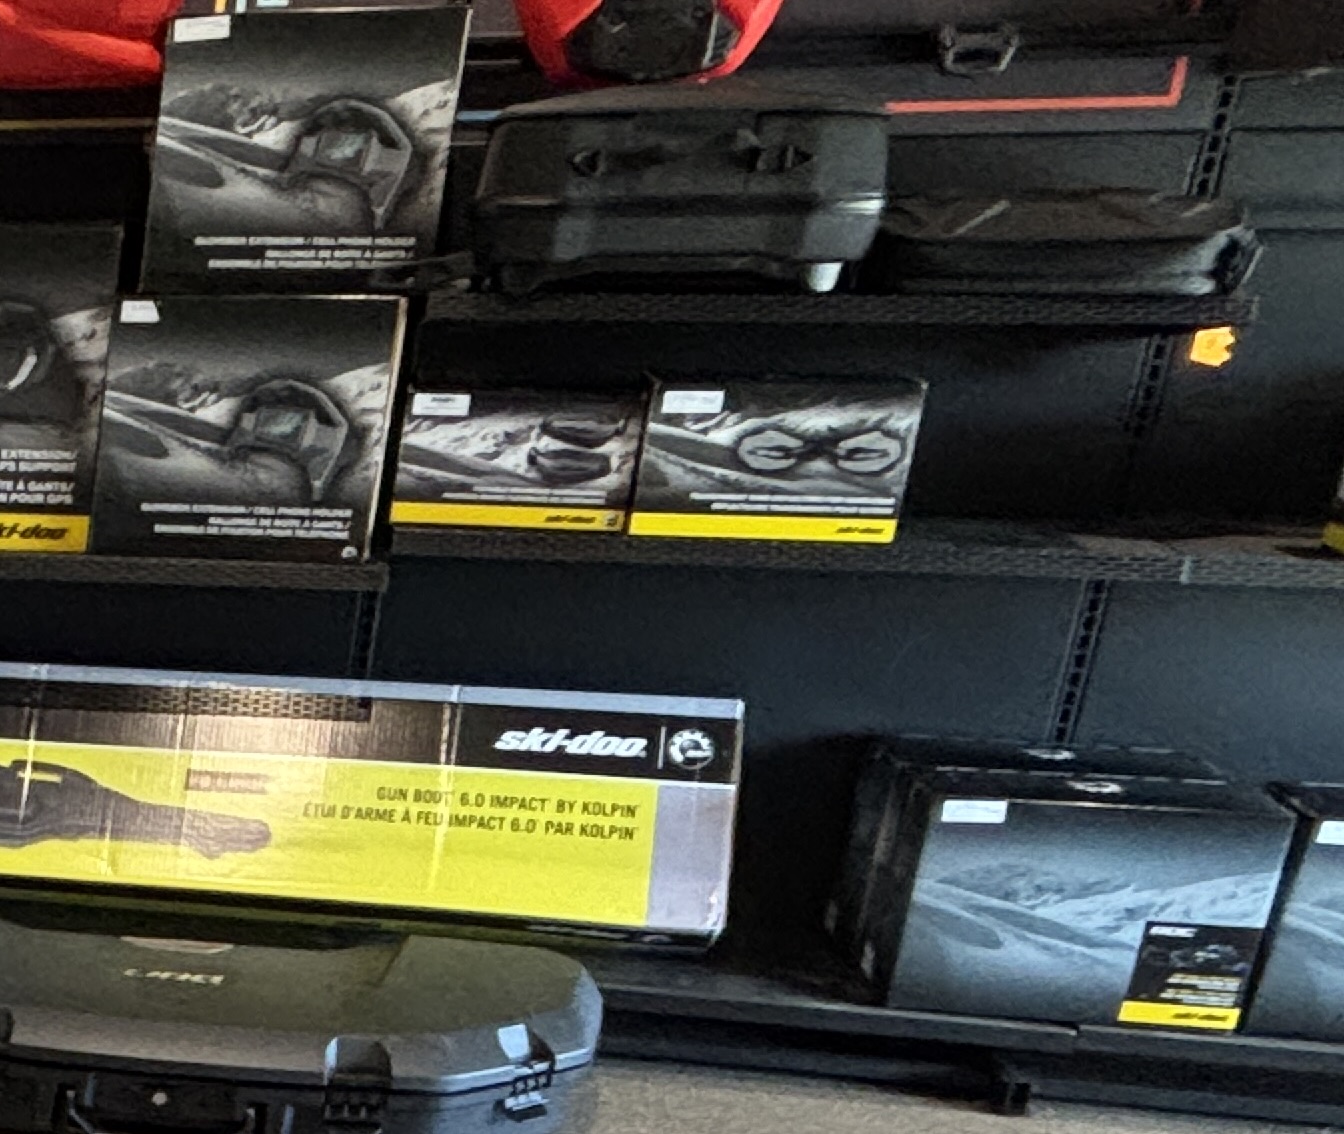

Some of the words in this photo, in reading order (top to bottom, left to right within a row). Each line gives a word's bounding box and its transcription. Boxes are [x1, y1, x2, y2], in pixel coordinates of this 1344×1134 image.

[494, 726, 648, 757] ski-doo
[376, 786, 408, 802] GUN
[459, 792, 486, 808] 6.0
[489, 794, 548, 813] IMPACT
[555, 798, 577, 814] BY
[302, 800, 337, 818] ÉTUI
[340, 804, 397, 823] D'ARME
[400, 806, 412, 825] À
[448, 813, 505, 831] IMPACT
[544, 820, 575, 836] PAR
